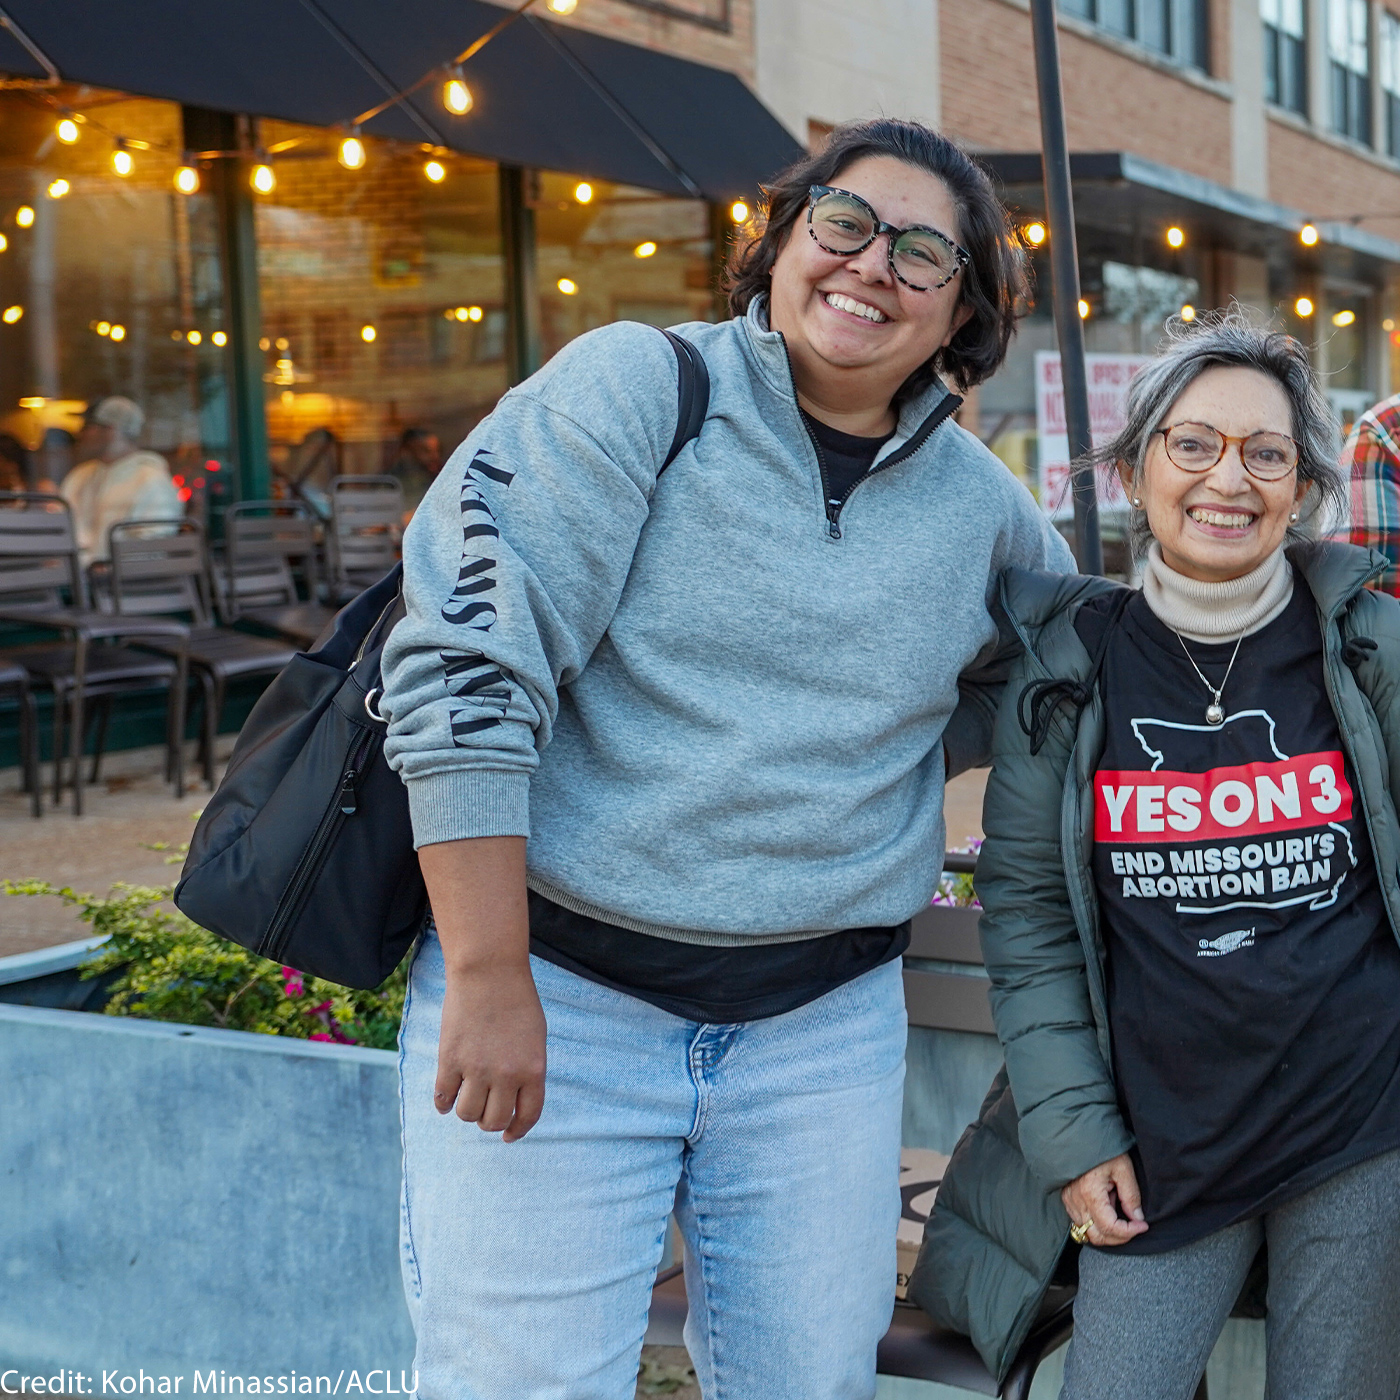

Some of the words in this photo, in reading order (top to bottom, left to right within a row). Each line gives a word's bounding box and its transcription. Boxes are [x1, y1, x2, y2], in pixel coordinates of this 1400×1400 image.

[441, 449, 517, 632] SWIFT
[1102, 785, 1202, 833] YES
[1209, 771, 1302, 828] ON
[1308, 764, 1342, 814] 3
[1111, 851, 1165, 875] END
[1169, 833, 1335, 874] MISSOURI'S
[1122, 870, 1265, 898] ABORTION
[1271, 858, 1331, 892] BAN
